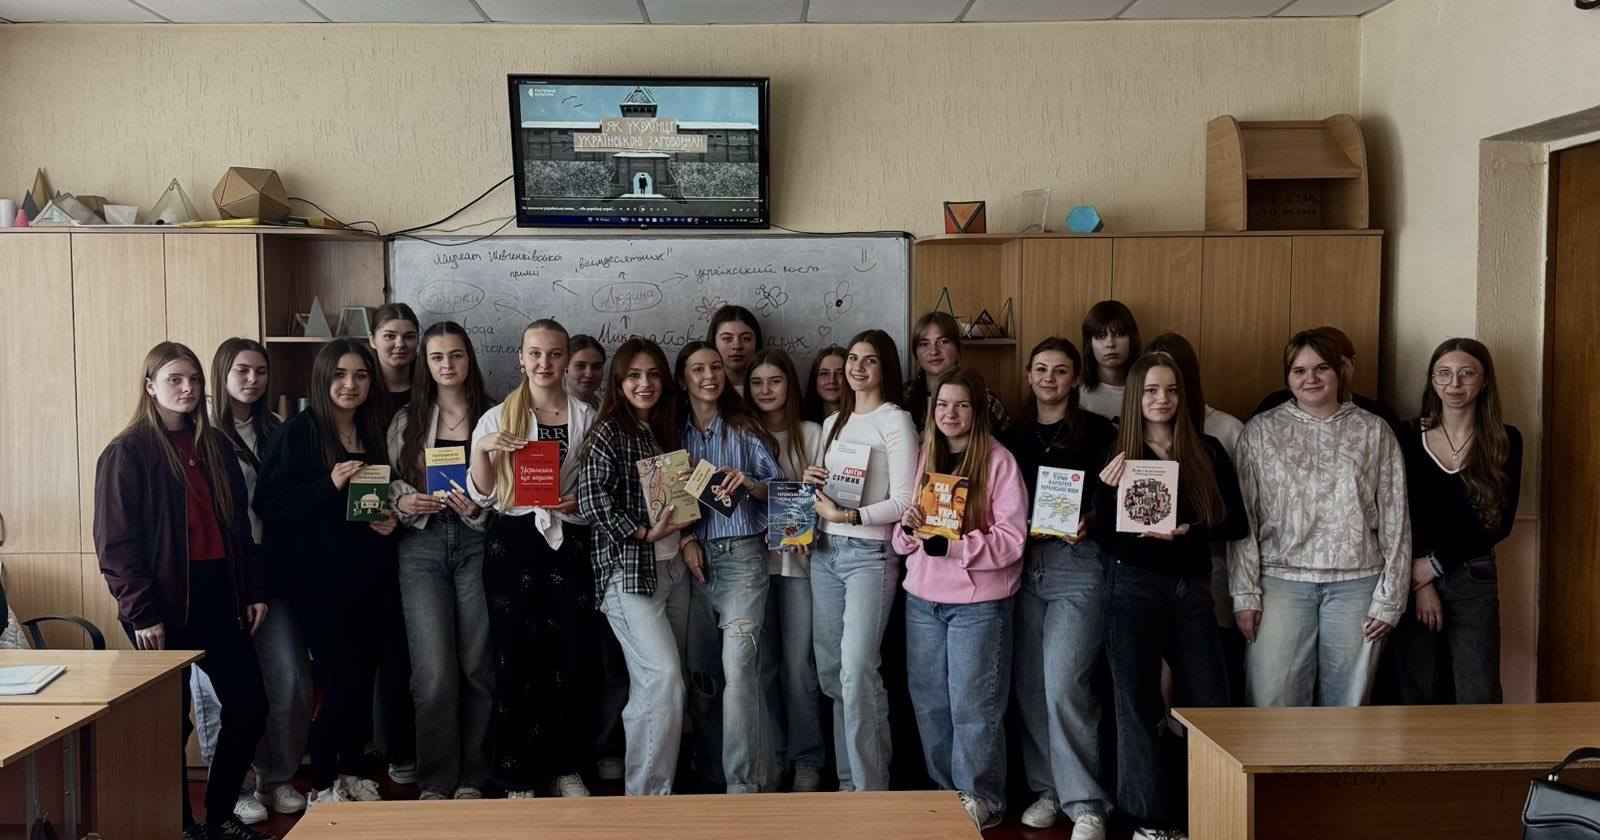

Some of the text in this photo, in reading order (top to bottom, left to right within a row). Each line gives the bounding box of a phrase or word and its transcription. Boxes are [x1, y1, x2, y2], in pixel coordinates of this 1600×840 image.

[606, 119, 674, 135] ЯК УКРАЇНЦІ
[577, 133, 704, 150] УКРАЇНСЬКОЮ ЗАГОВОРИЛИ
[843, 468, 863, 477] АНТИ
[832, 474, 860, 485] СУРЖИК
